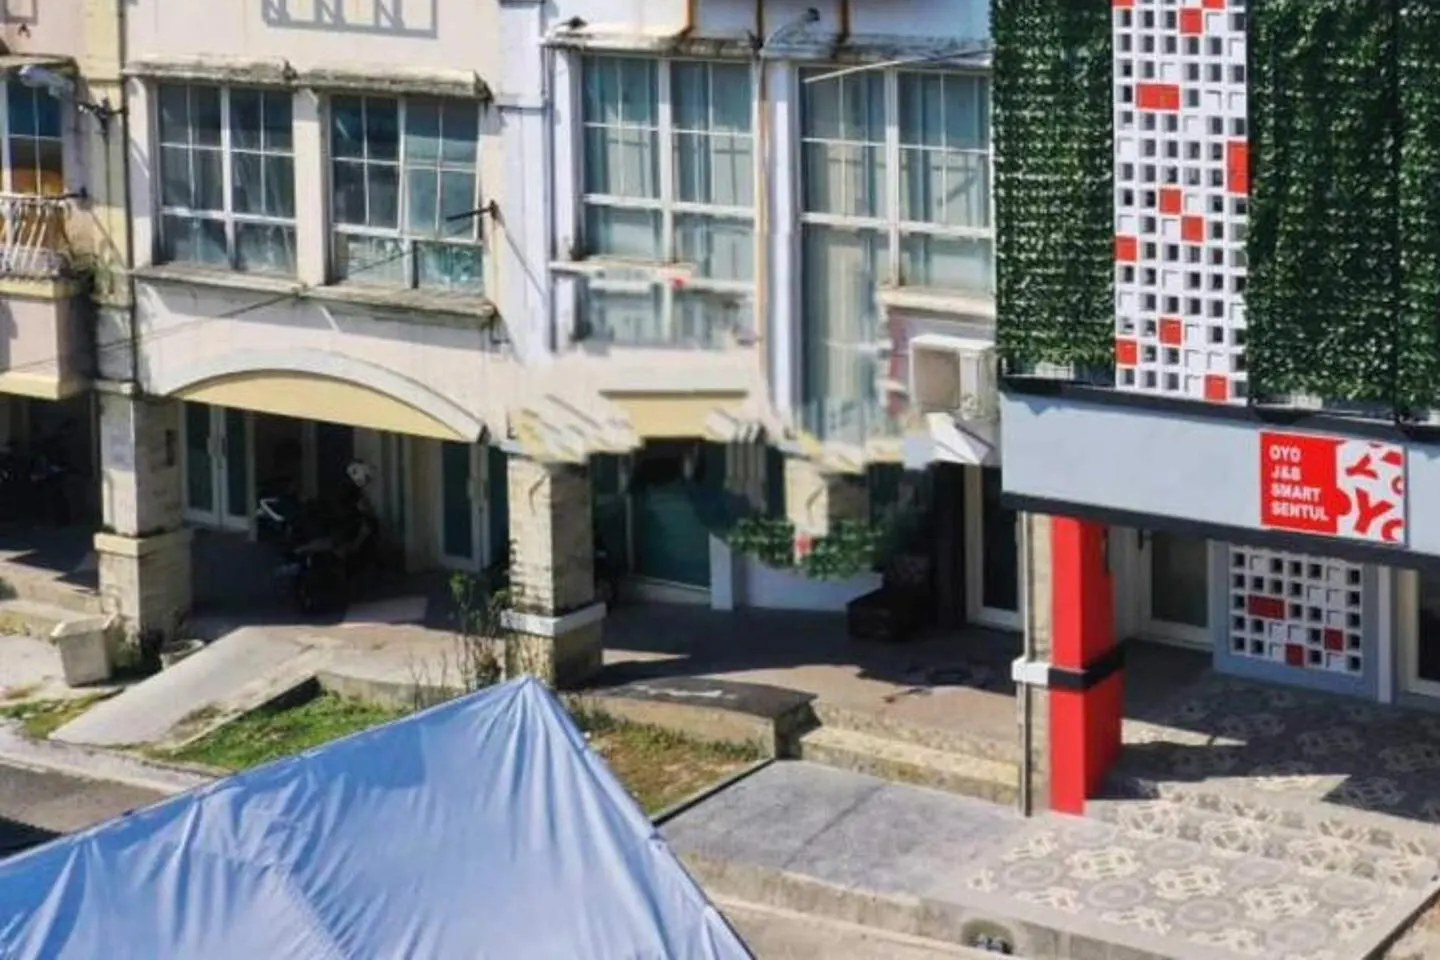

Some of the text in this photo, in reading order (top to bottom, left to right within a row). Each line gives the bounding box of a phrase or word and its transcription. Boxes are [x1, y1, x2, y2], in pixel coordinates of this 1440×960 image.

[1269, 445, 1301, 462] OYO
[1271, 483, 1321, 503] SMART
[1271, 501, 1330, 522] SENTUL
